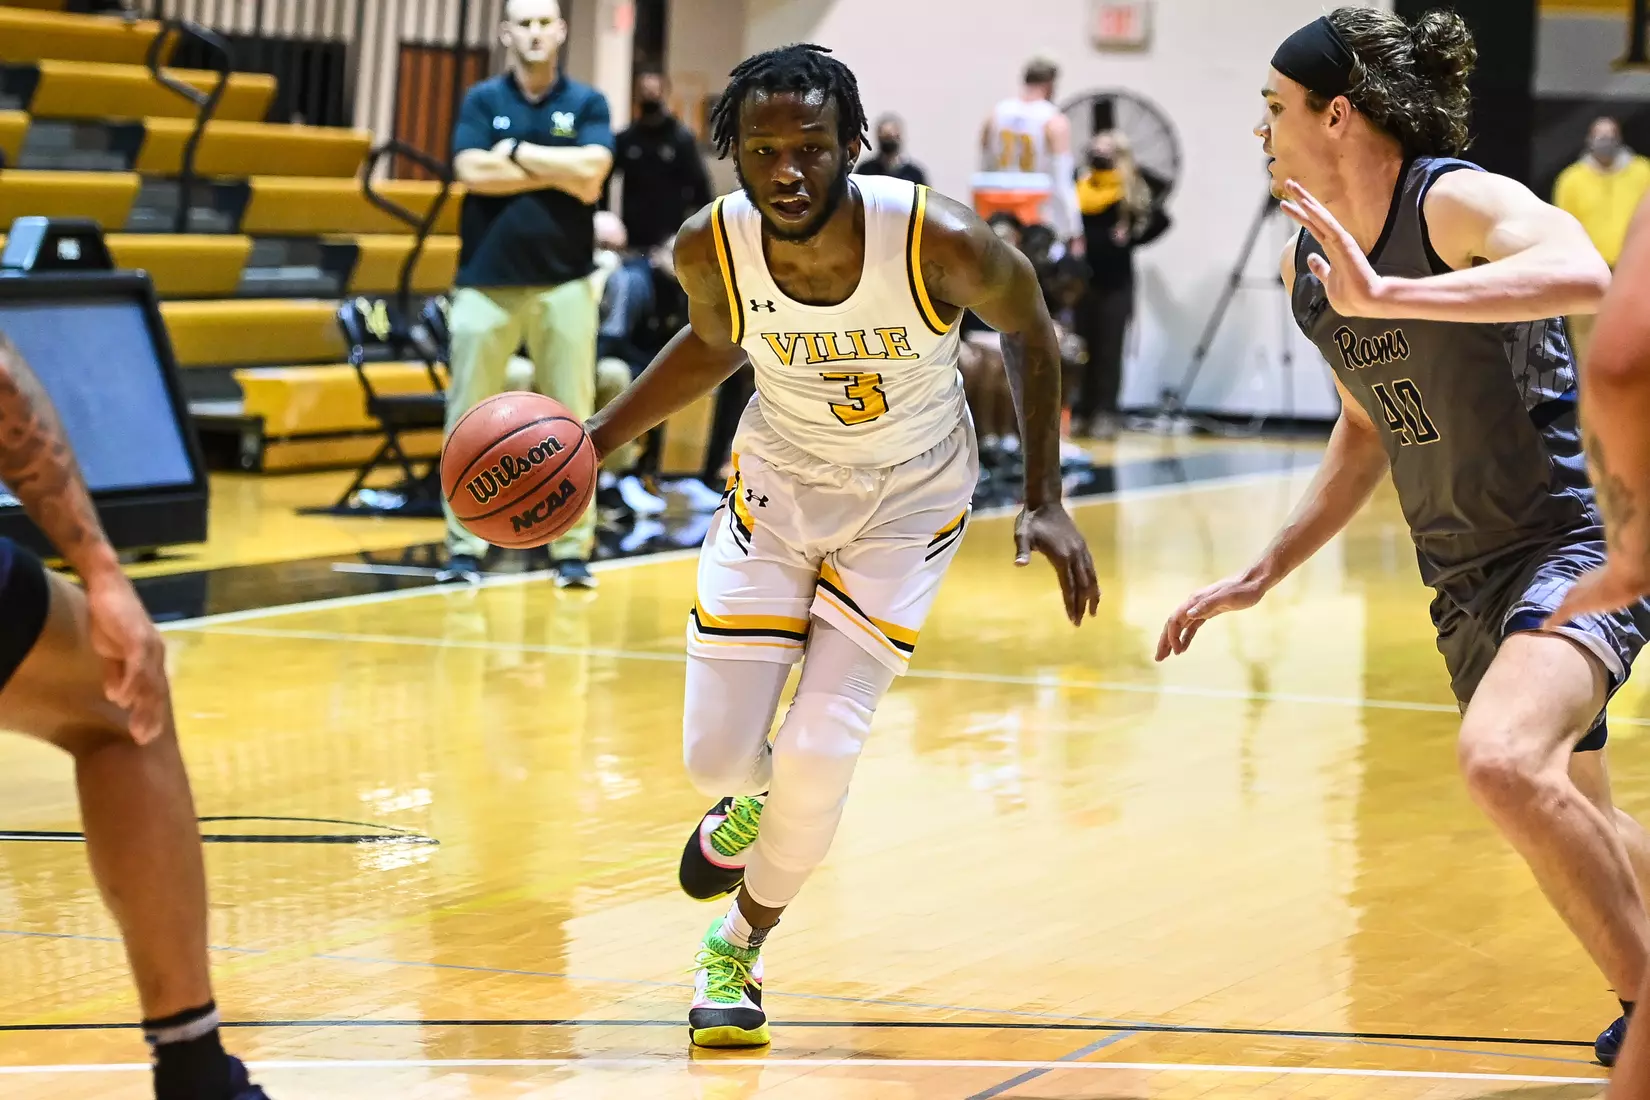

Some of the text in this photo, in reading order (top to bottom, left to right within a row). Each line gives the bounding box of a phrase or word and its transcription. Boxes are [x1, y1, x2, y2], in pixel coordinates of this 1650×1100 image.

[761, 326, 920, 366] VILLE
[1332, 325, 1411, 371] Rams
[819, 371, 889, 426] 3
[1371, 378, 1441, 446] 40
[464, 435, 567, 505] Wilson
[509, 477, 577, 533] NCAA
